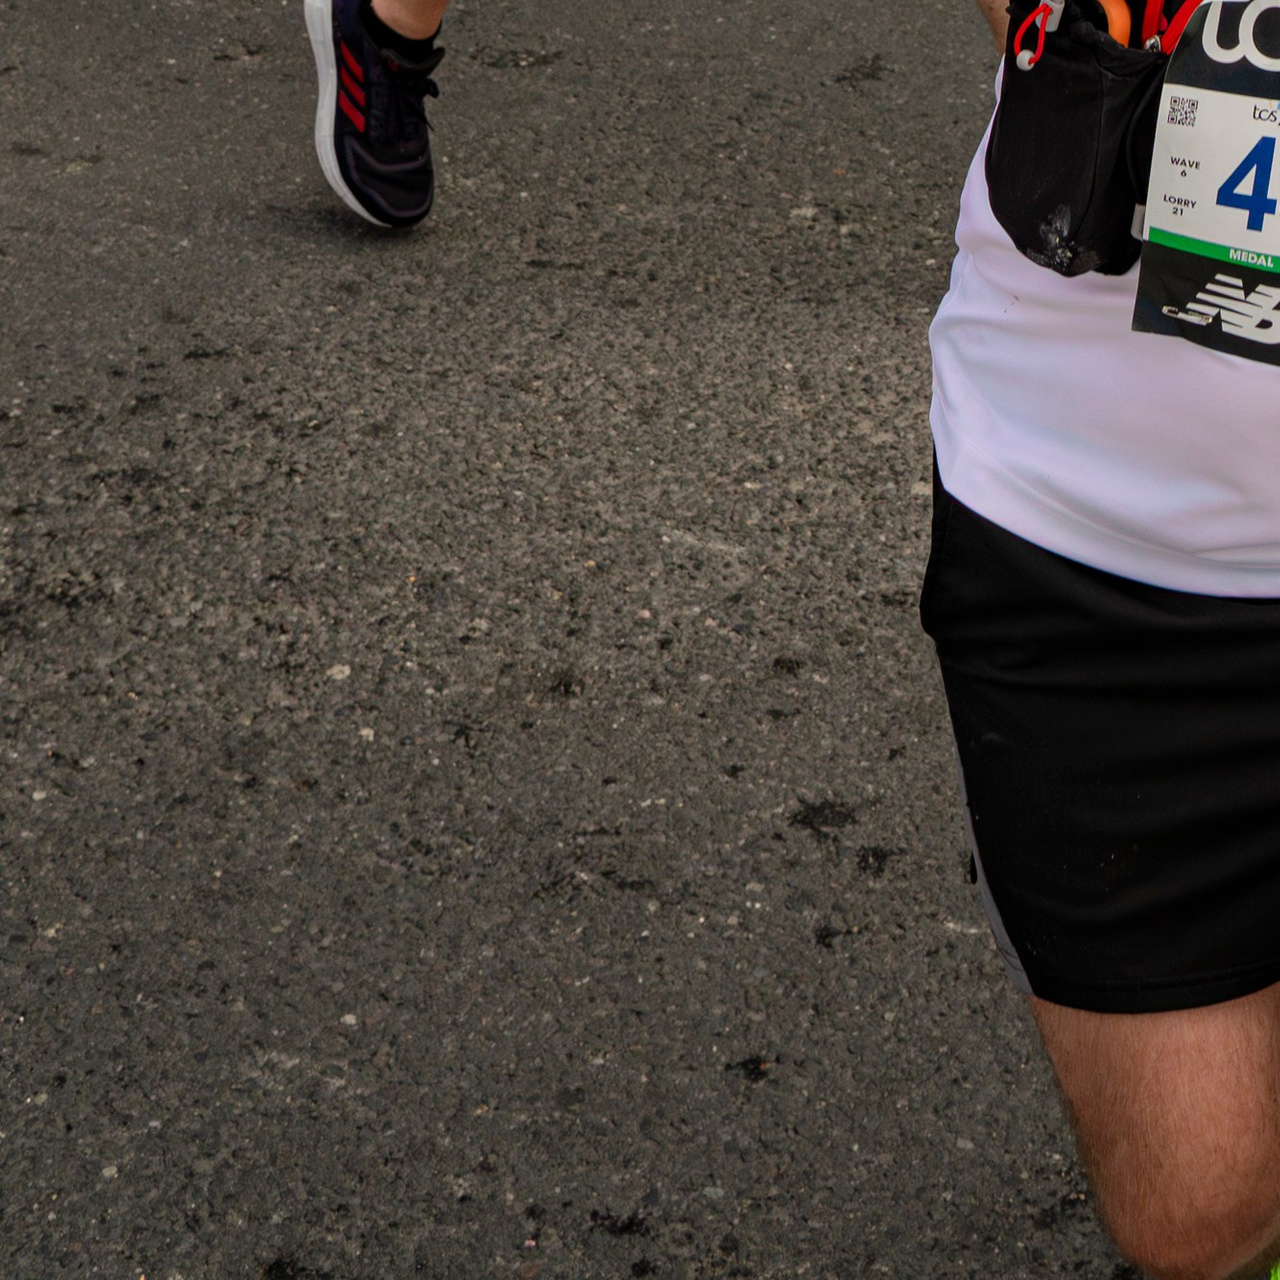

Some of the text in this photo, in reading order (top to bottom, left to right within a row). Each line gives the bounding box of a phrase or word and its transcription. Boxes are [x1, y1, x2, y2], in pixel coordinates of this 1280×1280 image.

[1170, 156, 1201, 171] WAVE
[1180, 169, 1187, 178] 6
[1163, 193, 1197, 209] LORRY
[1172, 206, 1184, 217] 21
[1229, 248, 1275, 268] MEDAL
